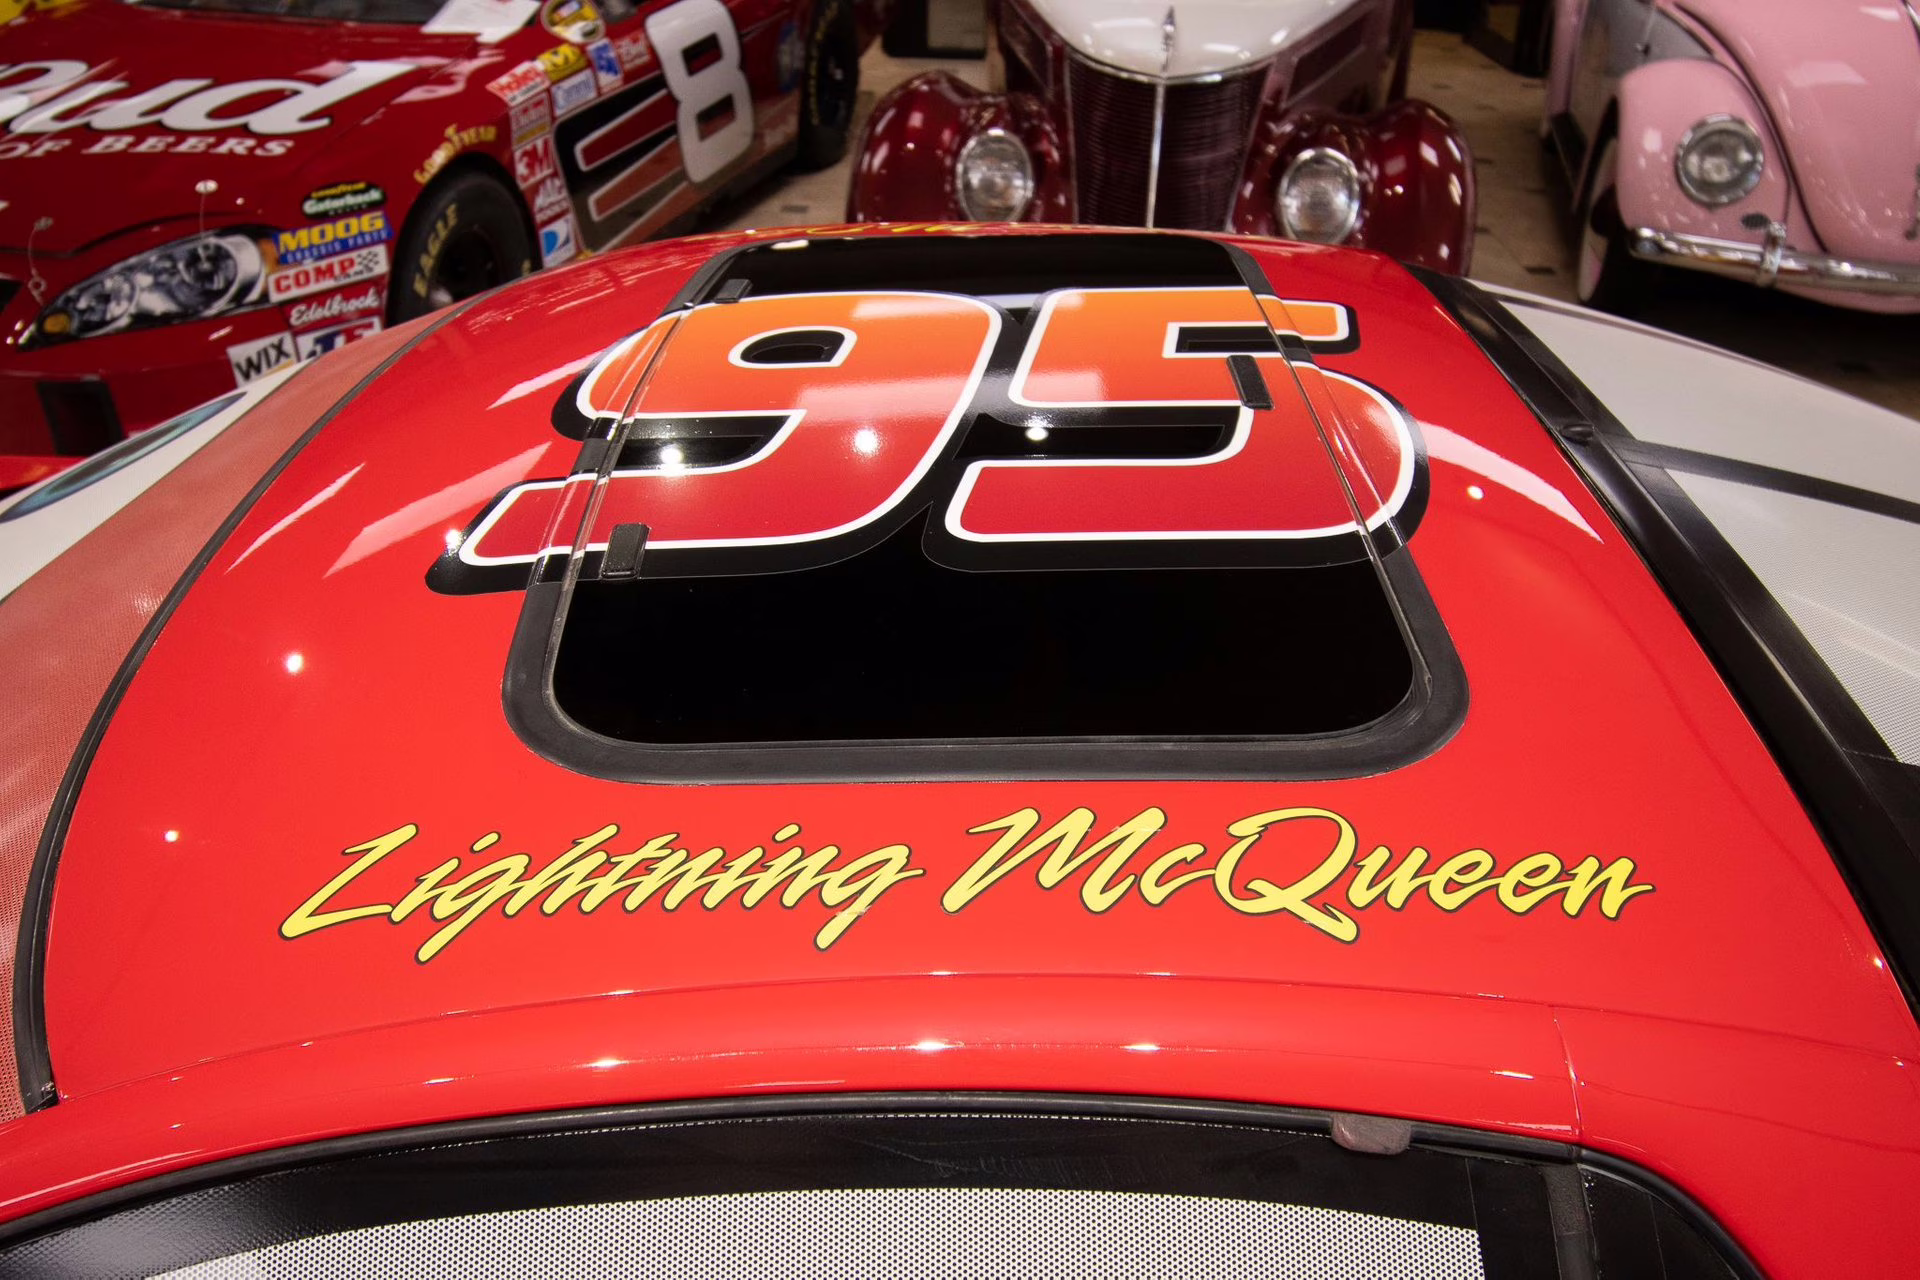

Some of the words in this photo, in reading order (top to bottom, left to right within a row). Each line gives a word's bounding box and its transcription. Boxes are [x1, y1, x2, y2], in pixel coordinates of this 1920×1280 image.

[644, 0, 754, 184] 8
[80, 134, 295, 156] BEERS
[516, 138, 556, 185] 3M
[279, 210, 385, 254] MOOG
[413, 203, 458, 298] EAGLE
[275, 257, 355, 294] COMP
[289, 286, 379, 326] Edelbrock
[235, 336, 290, 381] WIX
[427, 286, 1430, 595] 95
[280, 823, 924, 965] Lightning
[941, 805, 1657, 945] McQueen
